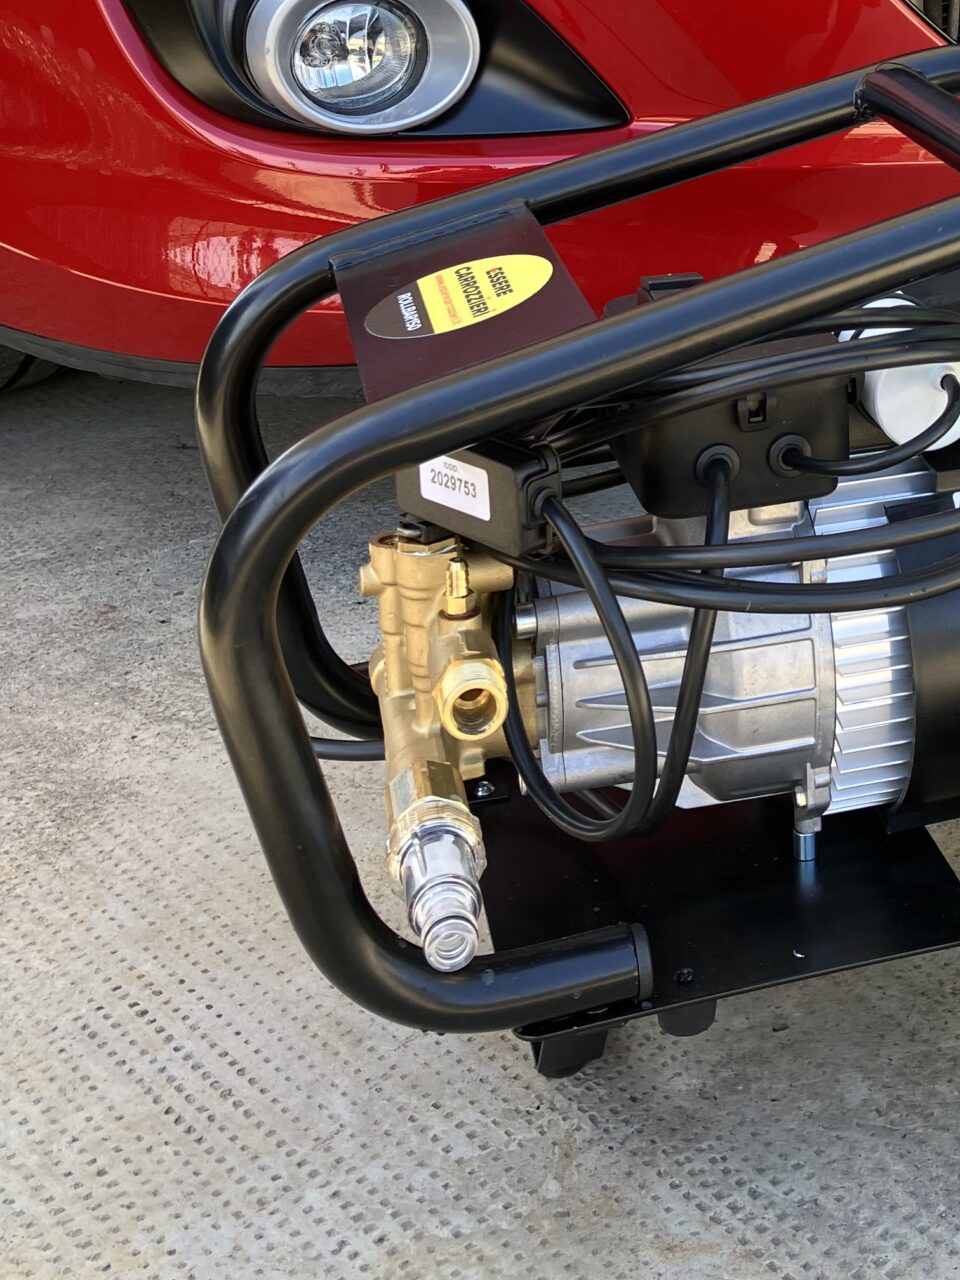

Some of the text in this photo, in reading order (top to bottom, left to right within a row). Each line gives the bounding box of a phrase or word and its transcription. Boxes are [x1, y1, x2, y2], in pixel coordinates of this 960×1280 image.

[454, 266, 490, 318] CARROZZIERI
[485, 266, 514, 298] ESSERE
[430, 468, 477, 498] 2029753
